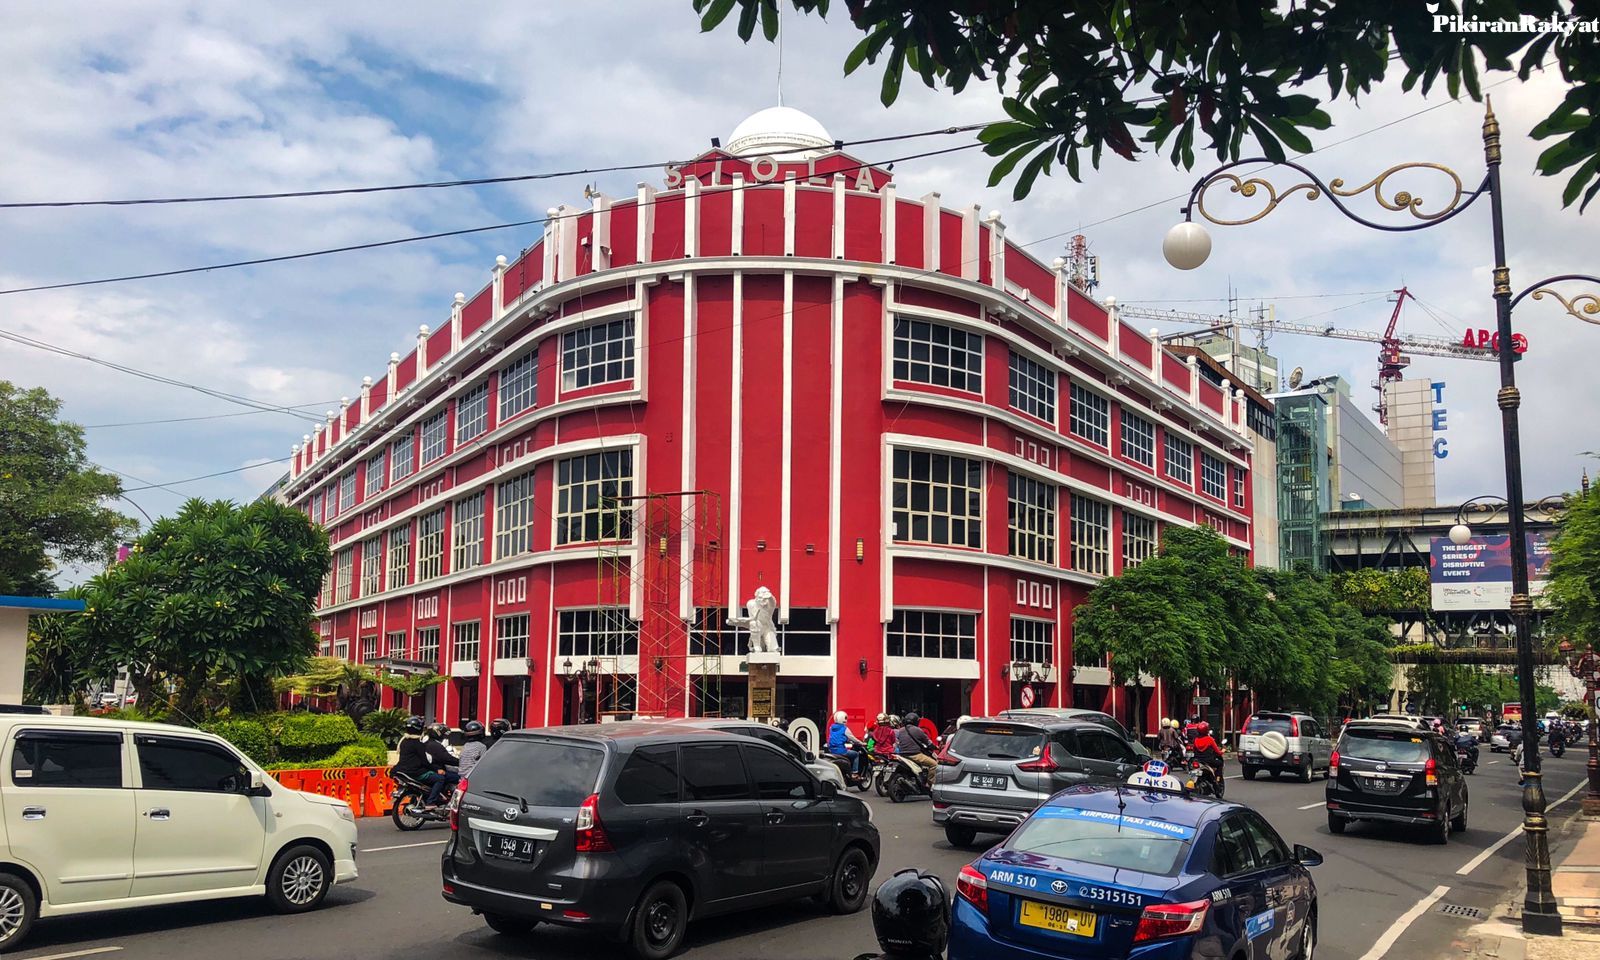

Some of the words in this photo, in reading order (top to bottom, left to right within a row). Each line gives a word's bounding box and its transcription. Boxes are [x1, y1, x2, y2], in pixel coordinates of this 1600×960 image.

[663, 155, 876, 192] SIOLA
[1431, 381, 1449, 459] TEC
[1443, 569, 1471, 577] EVENTS
[1136, 776, 1174, 789] TAKSI
[1079, 810, 1119, 820] AIRPORT
[1122, 815, 1144, 825] TAXI
[1145, 819, 1185, 834] JUANDA
[487, 835, 493, 848] L
[500, 838, 517, 851] 1548
[990, 869, 1013, 883] ARM
[1016, 874, 1037, 888] 510
[1090, 887, 1142, 906] 5315151
[1211, 891, 1224, 902] ARM
[1023, 902, 1030, 917] L
[1043, 906, 1069, 923] 1980
[1079, 913, 1095, 928] UV
